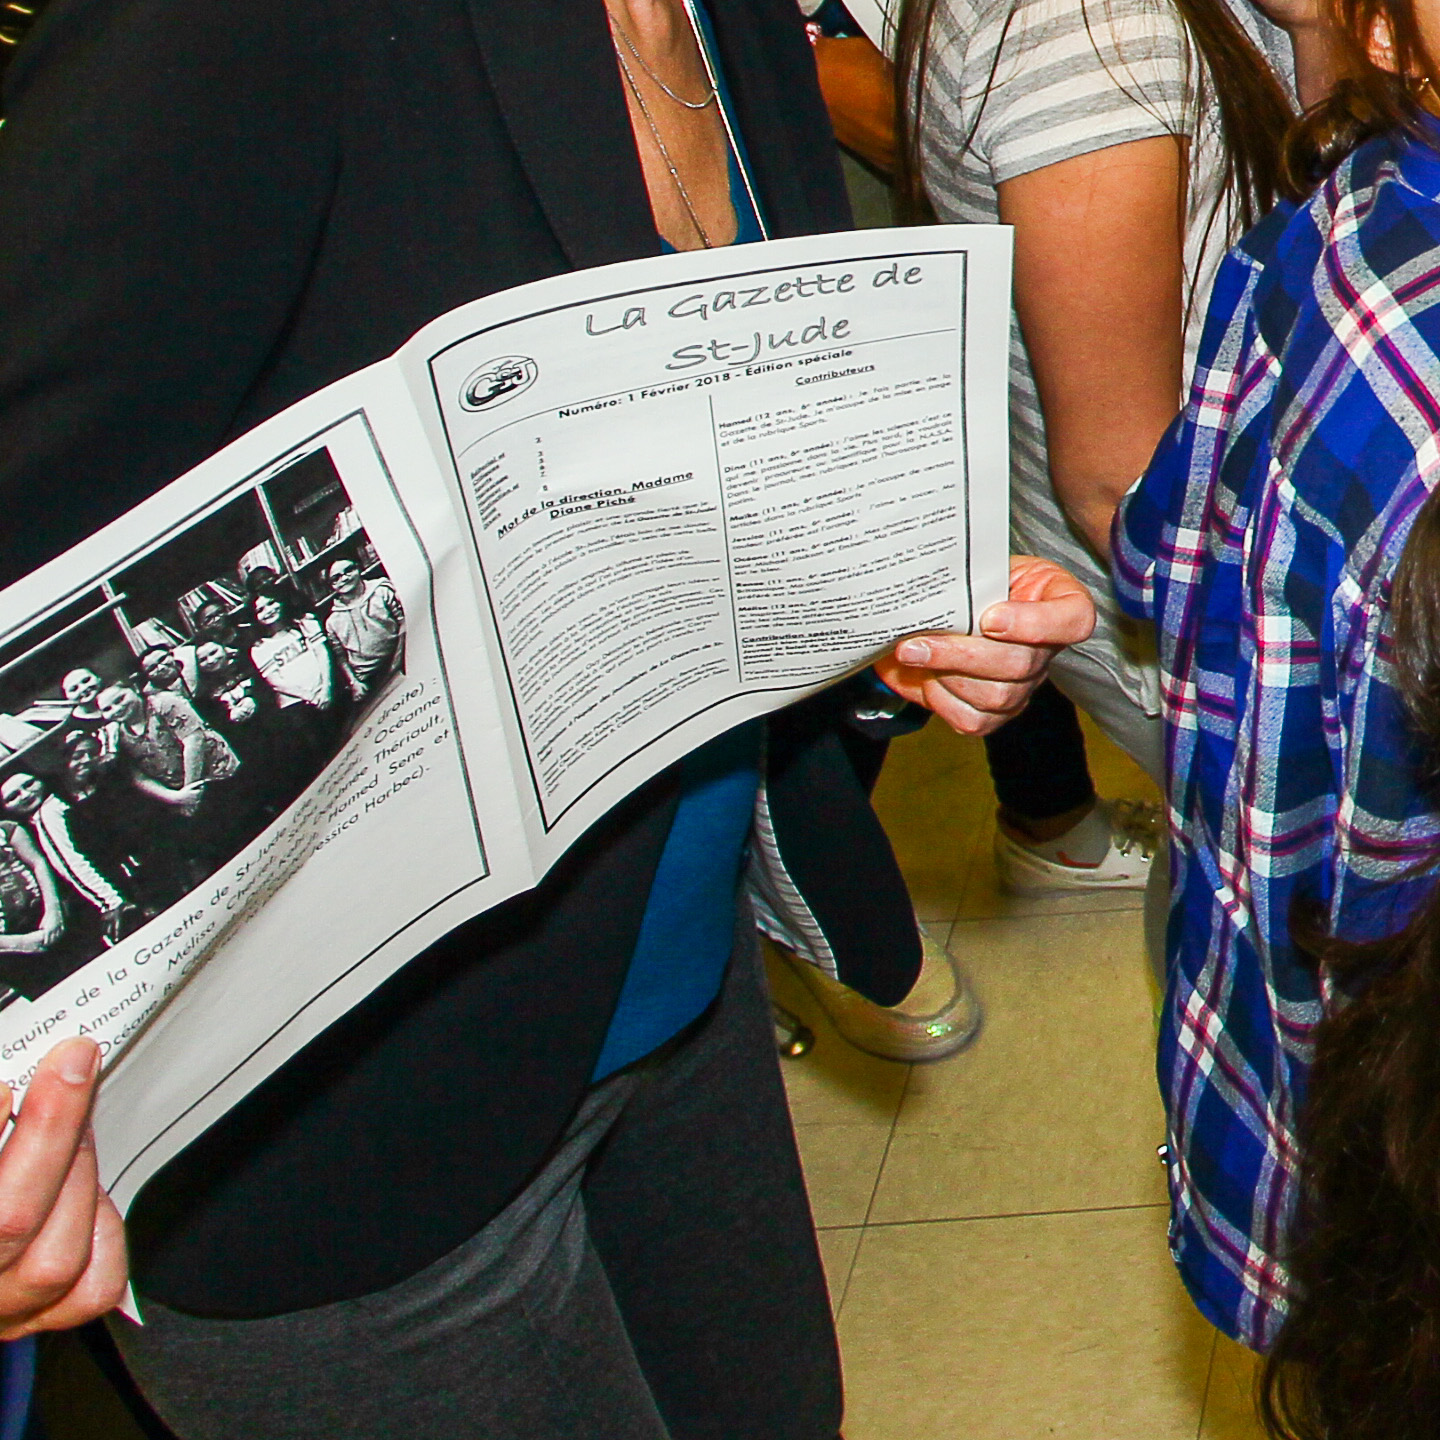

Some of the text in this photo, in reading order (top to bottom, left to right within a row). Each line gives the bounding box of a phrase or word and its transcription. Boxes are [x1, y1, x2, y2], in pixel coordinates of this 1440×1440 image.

[585, 262, 923, 337] La Gazette de
[665, 316, 851, 371] St-Jude
[795, 363, 875, 386] Contributeurs
[558, 348, 853, 420] Numéro: 1 Février 2018 Édition spéciale
[498, 470, 694, 539] Mot de la direction, Madame
[550, 495, 636, 520] Diane Piché
[377, 682, 424, 725] droite)
[389, 746, 425, 775] Sene
[434, 729, 449, 744] et
[75, 986, 100, 1007] de
[107, 967, 128, 986] la
[134, 909, 204, 966] Gazette
[210, 885, 230, 906] de
[78, 921, 215, 1037] Amendt, Mélisa
